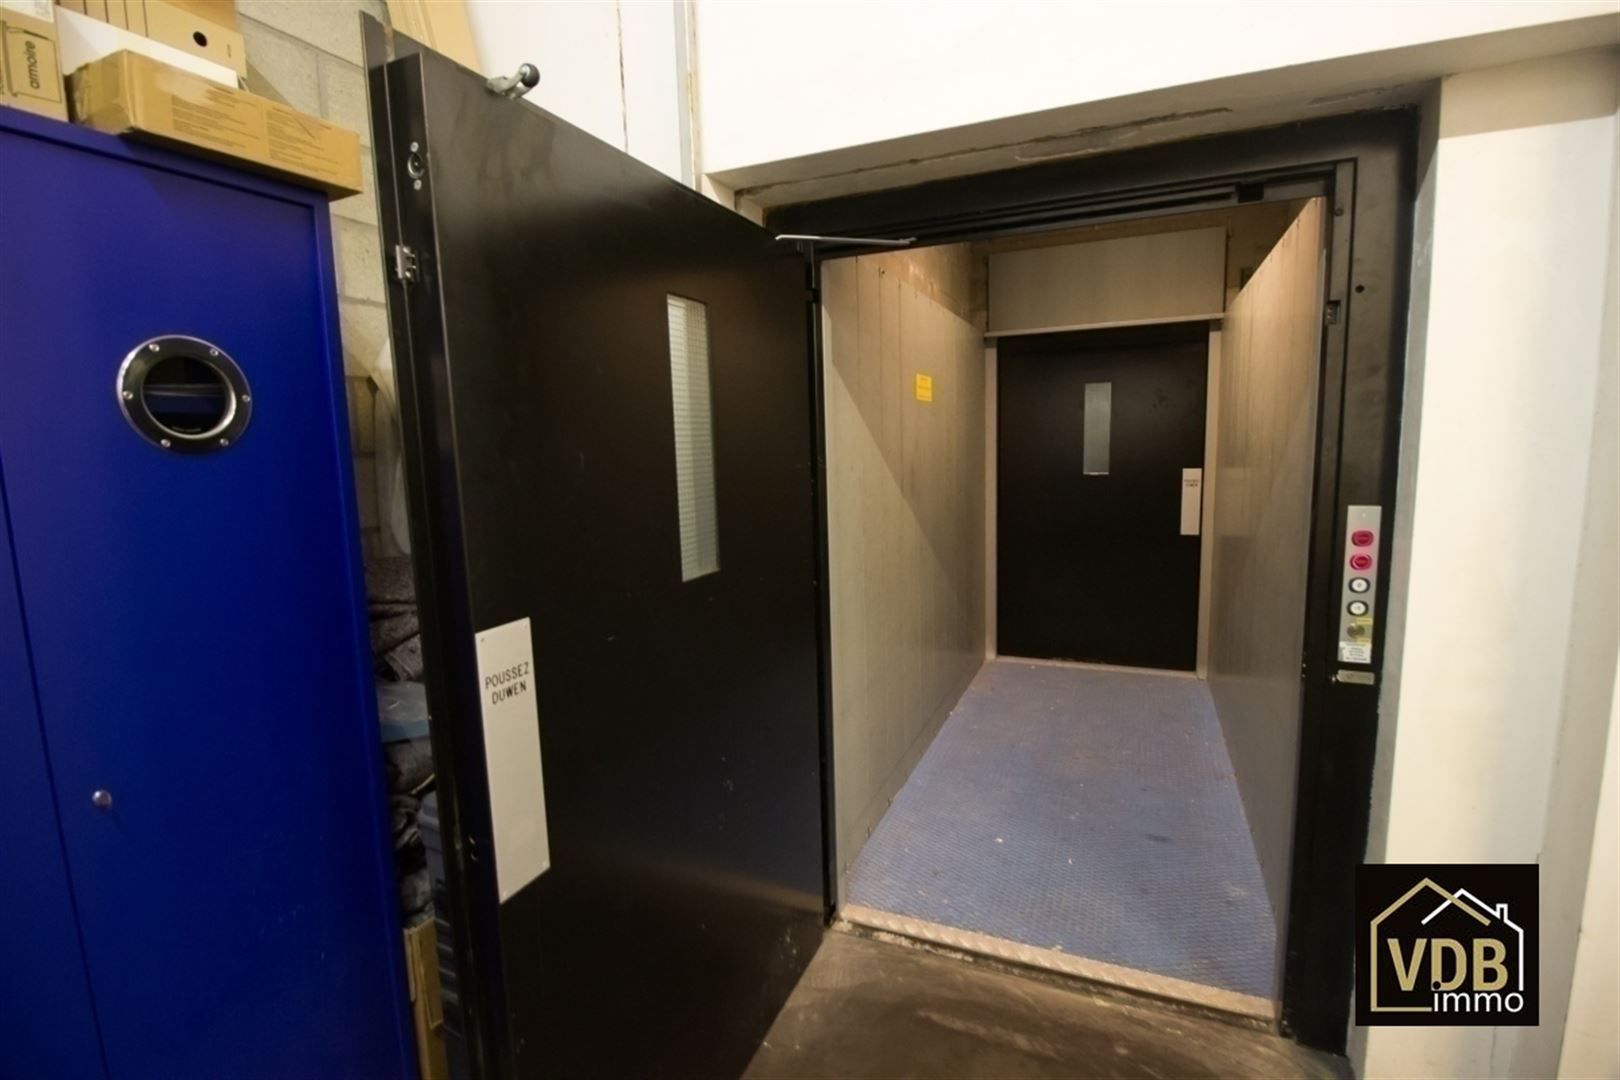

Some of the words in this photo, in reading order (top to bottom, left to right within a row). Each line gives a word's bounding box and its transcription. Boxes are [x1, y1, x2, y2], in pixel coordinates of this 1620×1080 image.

[25, 41, 40, 89] armoire
[485, 661, 529, 690] POUSSEZ
[492, 680, 527, 705] DUWEN
